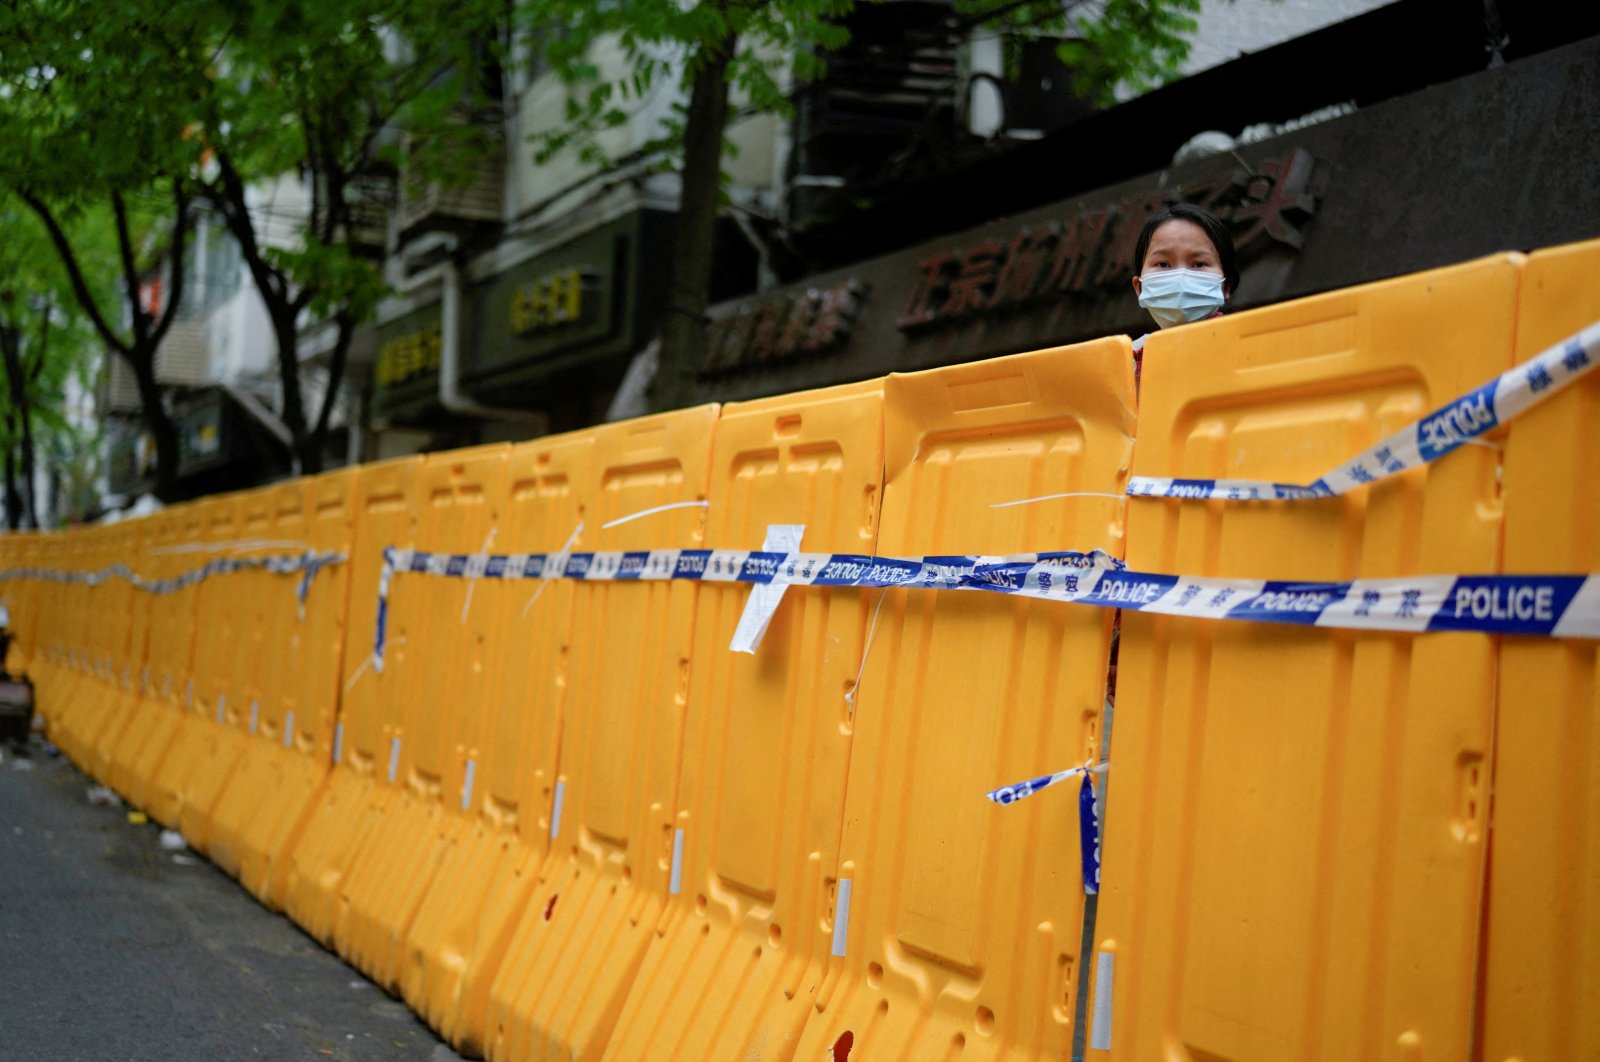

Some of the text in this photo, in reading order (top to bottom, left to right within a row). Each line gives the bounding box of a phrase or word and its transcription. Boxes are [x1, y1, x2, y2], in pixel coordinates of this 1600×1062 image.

[1422, 391, 1493, 452] POLICE
[746, 557, 780, 576] POLICE
[824, 562, 864, 580] POLICE
[867, 564, 911, 583] POLICE
[1097, 578, 1160, 603] POLICE
[1251, 590, 1333, 613] POLICE
[1454, 585, 1554, 621] POLICE
